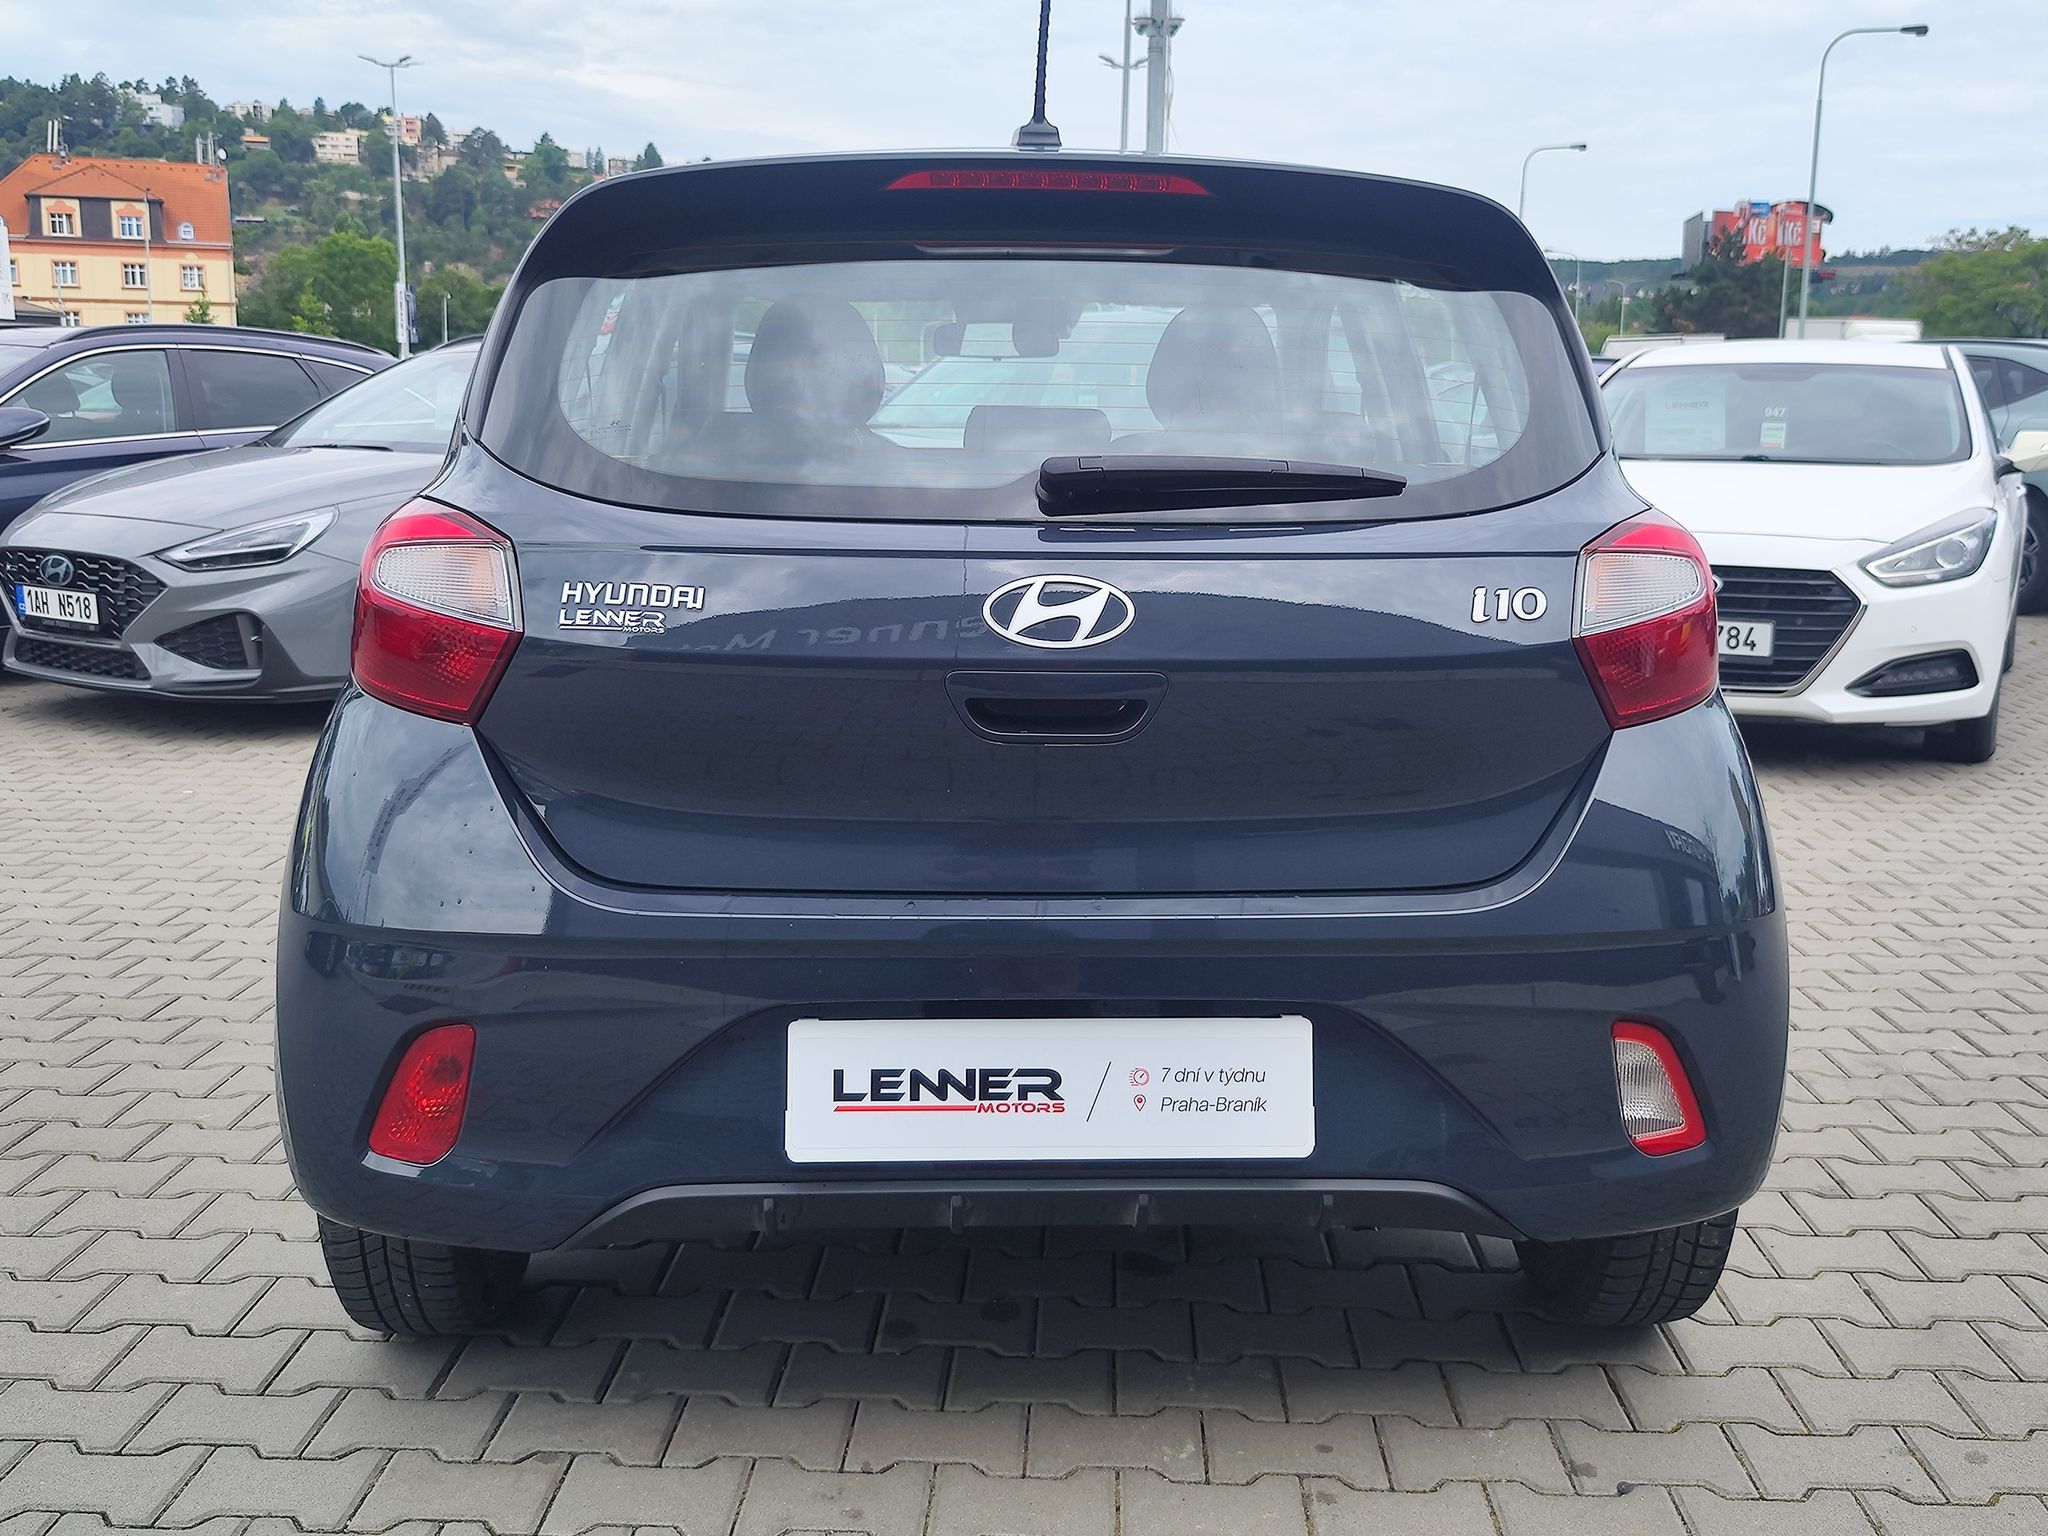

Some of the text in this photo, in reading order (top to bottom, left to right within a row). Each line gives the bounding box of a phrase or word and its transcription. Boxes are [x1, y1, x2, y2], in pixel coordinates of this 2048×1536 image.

[27, 589, 50, 615] 1AH
[58, 593, 92, 620] N518
[561, 582, 705, 610] HYUNDAI
[1472, 585, 1548, 623] i10
[559, 608, 667, 628] LENNER
[622, 626, 666, 634] MOTORS
[832, 1068, 1066, 1102] LENNER
[1161, 1065, 1267, 1088] 7 dní v týdnu
[977, 1101, 1066, 1114] MOTORS
[1160, 1093, 1268, 1113] Praha-Braník
